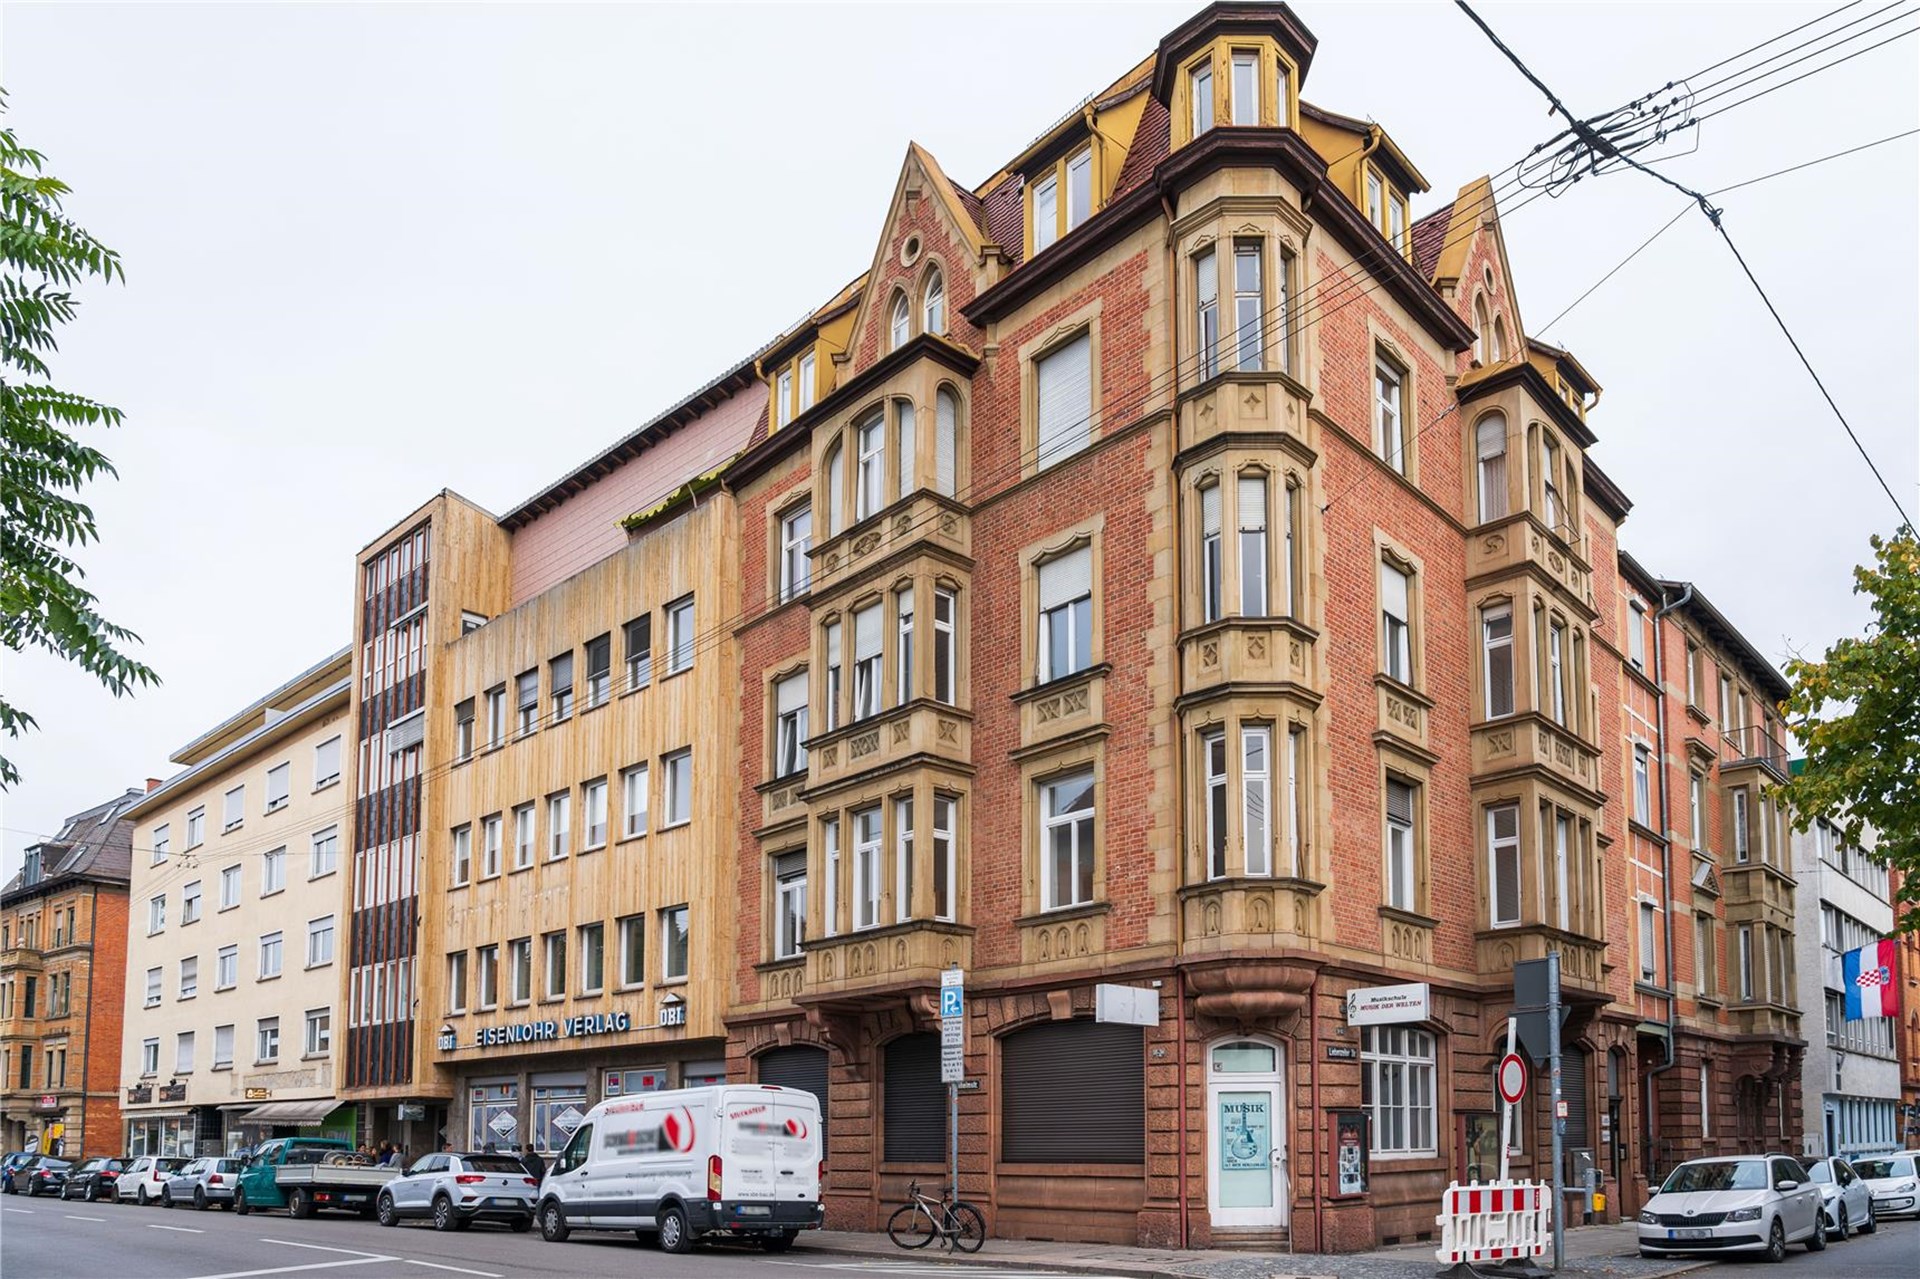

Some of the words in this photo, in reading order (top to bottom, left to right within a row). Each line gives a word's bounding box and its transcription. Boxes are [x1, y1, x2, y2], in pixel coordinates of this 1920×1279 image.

[944, 991, 957, 1014] P
[1371, 994, 1407, 1003] Musikschule
[1360, 1003, 1380, 1011] MUSIK
[1381, 1001, 1394, 1010] DER
[1396, 999, 1423, 1008] WELTEN
[475, 1021, 555, 1047] EISENLOHR
[563, 1012, 628, 1037] VERLAG
[1224, 1104, 1265, 1114] MUSIK
